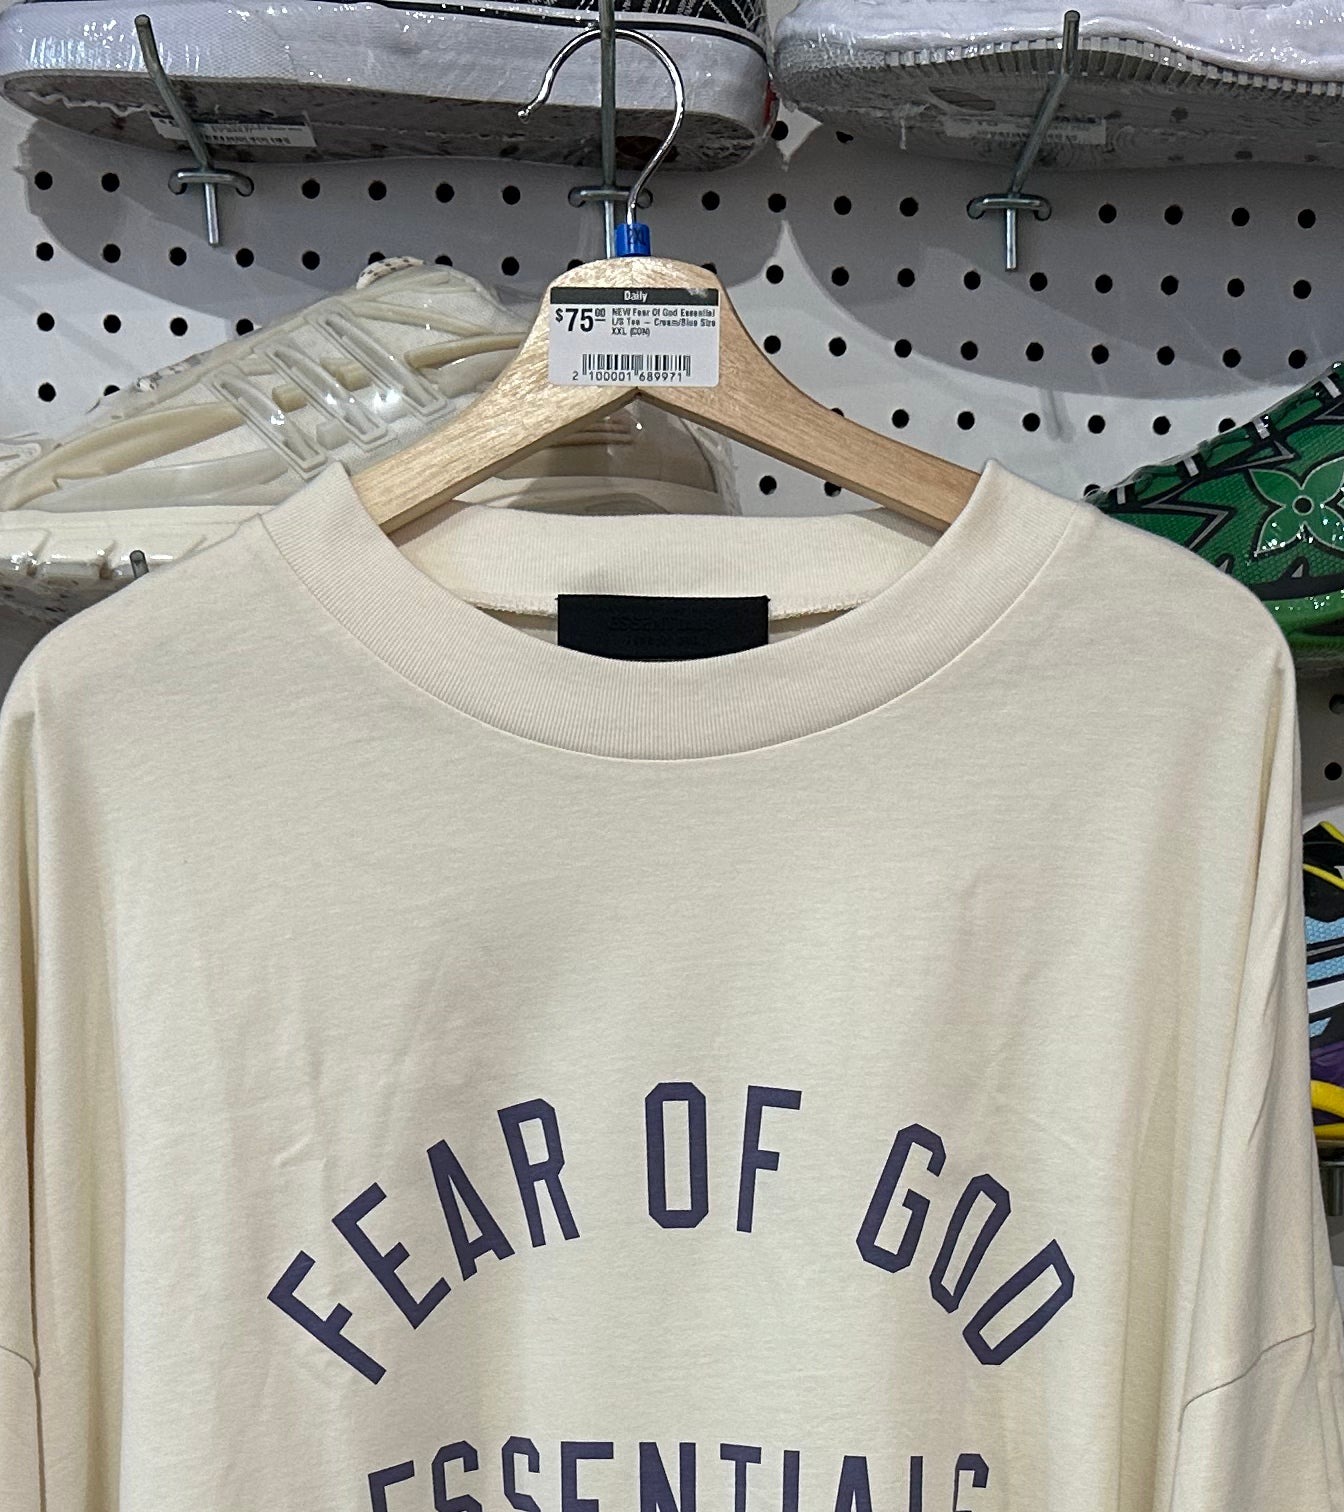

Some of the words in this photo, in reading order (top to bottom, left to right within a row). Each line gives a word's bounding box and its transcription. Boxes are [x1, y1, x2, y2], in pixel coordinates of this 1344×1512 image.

[624, 290, 649, 302] Daily
[612, 308, 632, 317] NEW
[632, 308, 651, 317] Fear
[652, 308, 661, 317] Of
[662, 308, 678, 317] God
[627, 318, 641, 326] Tee
[611, 327, 628, 336] XXL
[638, 371, 683, 382] 689971
[267, 1097, 581, 1386] FEAR
[644, 1081, 803, 1234] OF
[855, 1122, 1076, 1367] GOD
